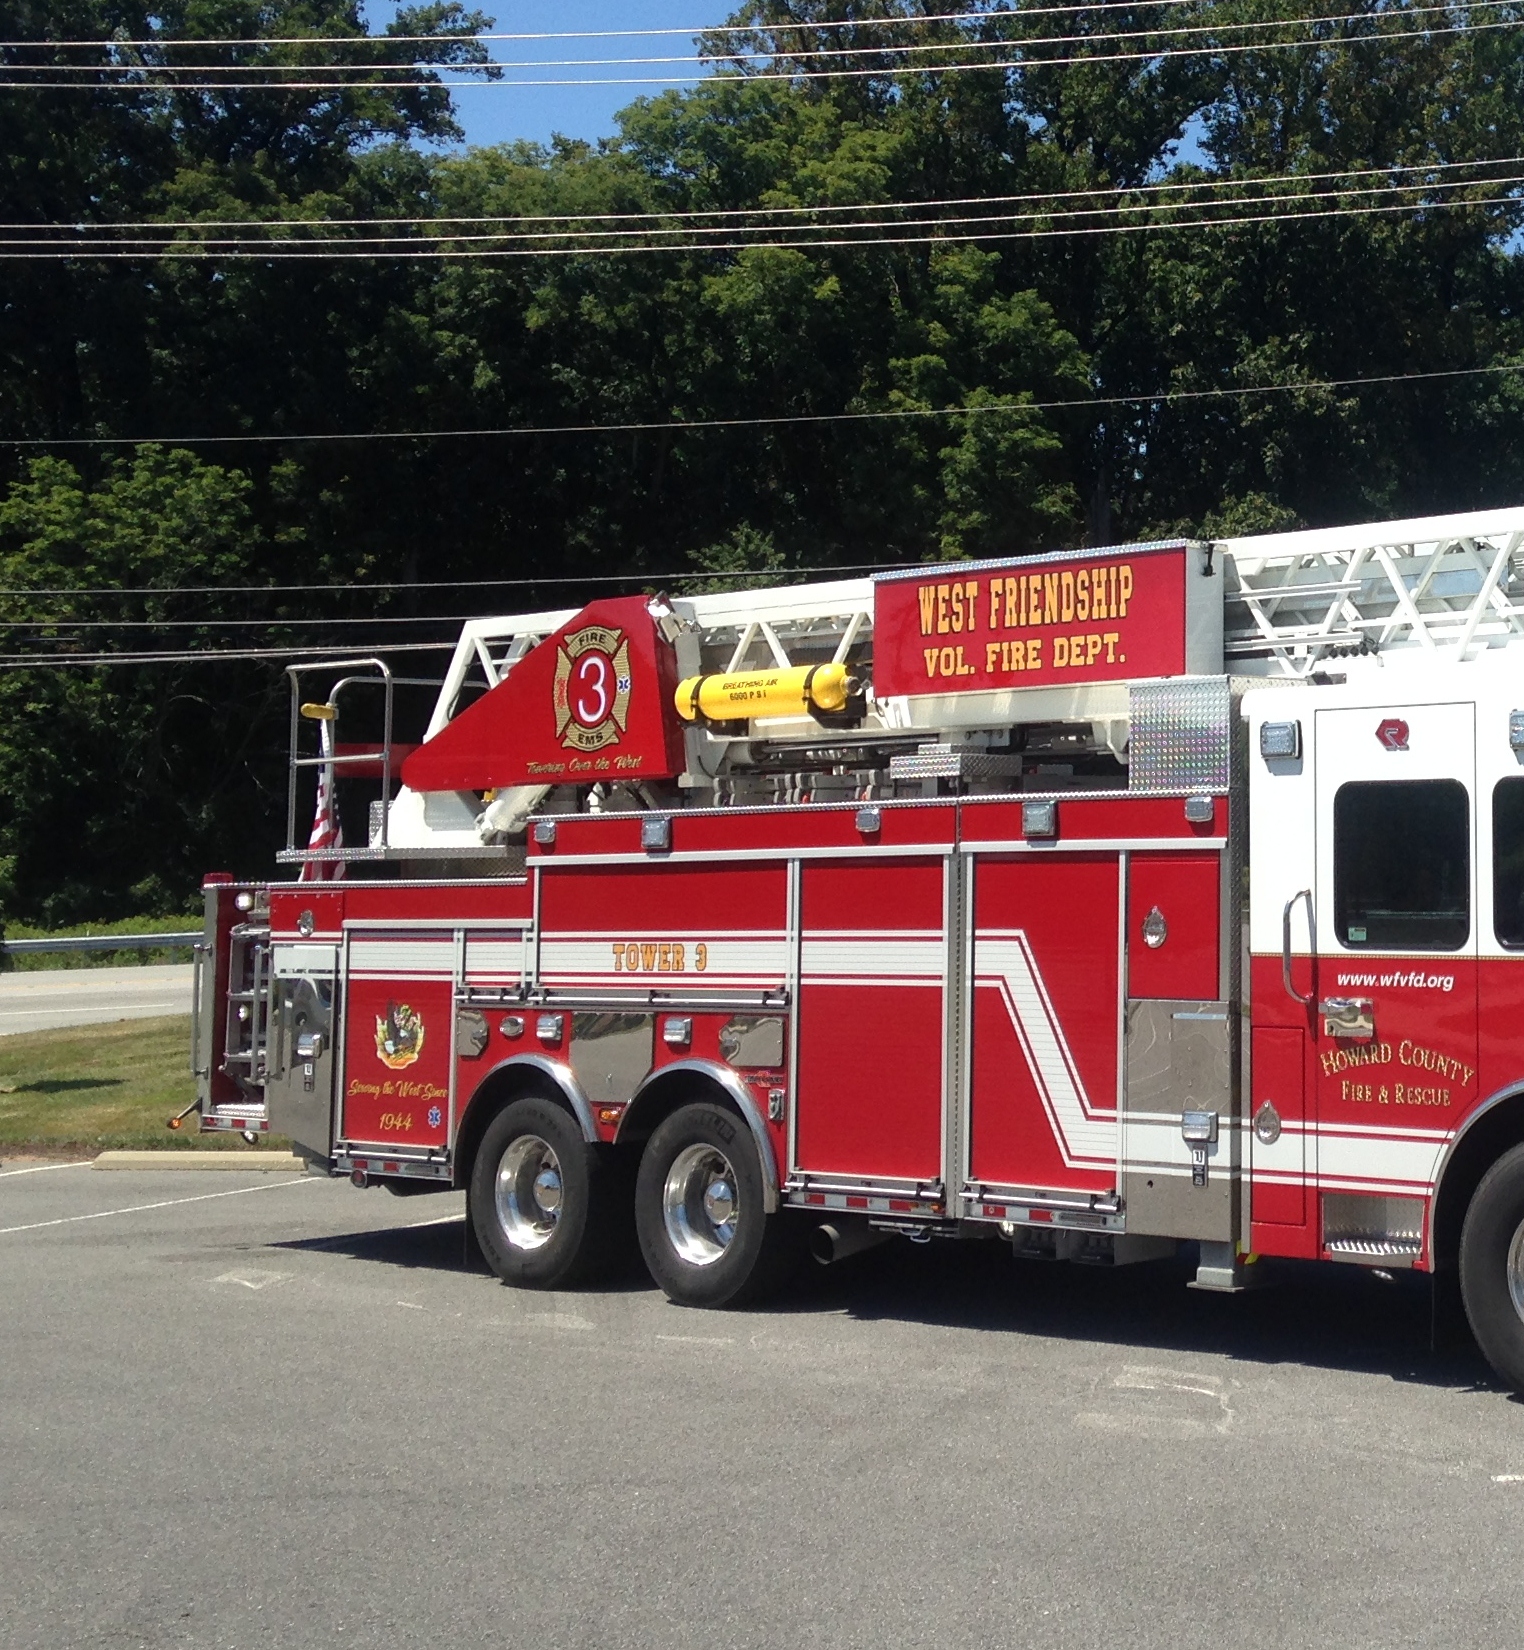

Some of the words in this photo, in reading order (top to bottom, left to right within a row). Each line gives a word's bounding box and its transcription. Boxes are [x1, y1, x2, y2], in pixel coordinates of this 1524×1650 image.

[918, 580, 979, 636] WEST
[989, 564, 1134, 630] FRIENDSHIP
[578, 632, 607, 647] FIRE
[923, 645, 976, 678] VOL.
[985, 638, 1043, 674] FIRE
[1052, 632, 1127, 669] DEPT.
[577, 655, 606, 723] 3
[577, 731, 604, 746] EMS
[568, 757, 592, 772] Over
[594, 757, 610, 770] the
[613, 753, 643, 770] West
[612, 943, 685, 972] TOWER
[695, 943, 707, 972] 3
[1337, 971, 1454, 992] www.wfvfd.org
[1319, 1042, 1393, 1078] HOWARD
[1398, 1038, 1475, 1088] COUNTY
[1341, 1079, 1373, 1103] FIRE
[1378, 1084, 1390, 1104] &
[1394, 1082, 1451, 1107] RESCUE
[378, 1110, 413, 1132] 1944
